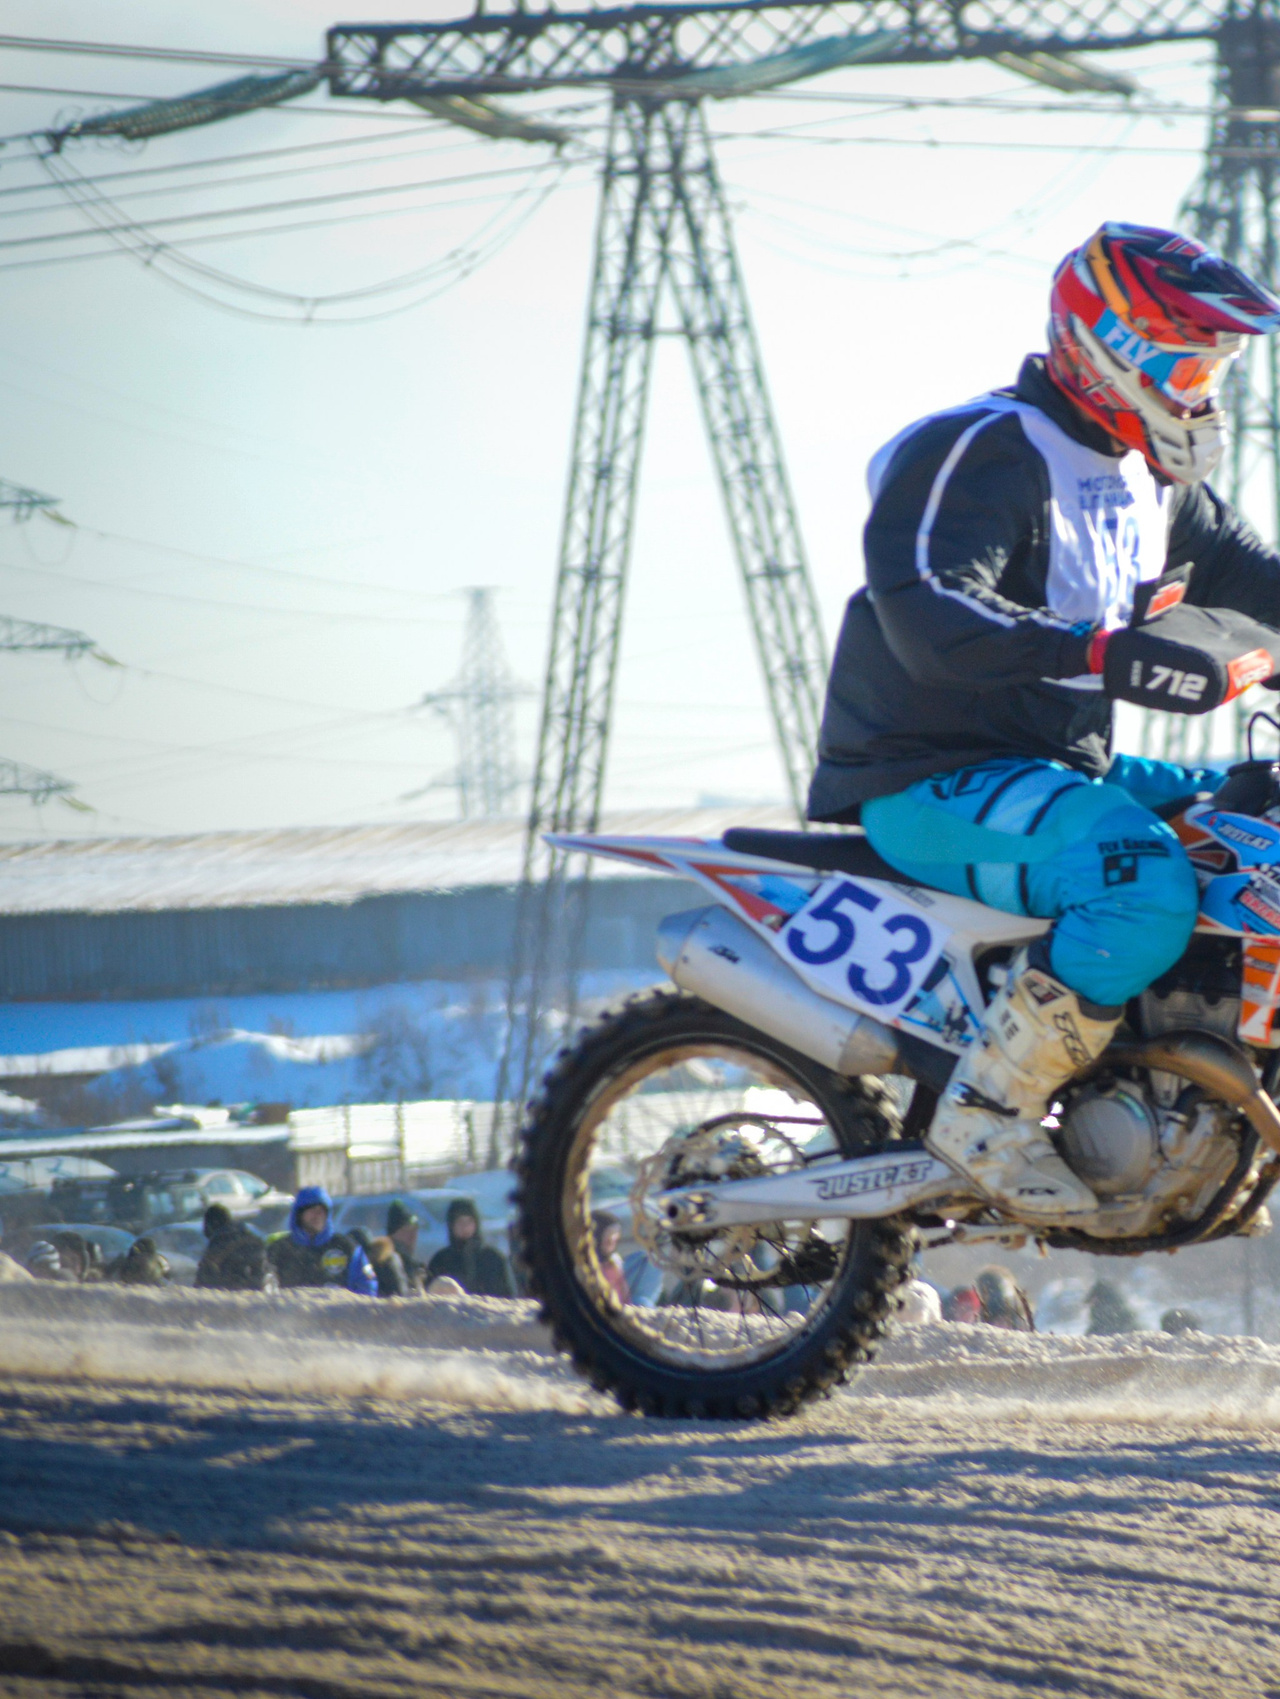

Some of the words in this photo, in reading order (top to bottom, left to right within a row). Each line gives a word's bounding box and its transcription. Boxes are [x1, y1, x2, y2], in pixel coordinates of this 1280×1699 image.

[1103, 317, 1162, 366] FLY
[1145, 664, 1209, 701] 712
[787, 880, 932, 1006] 53
